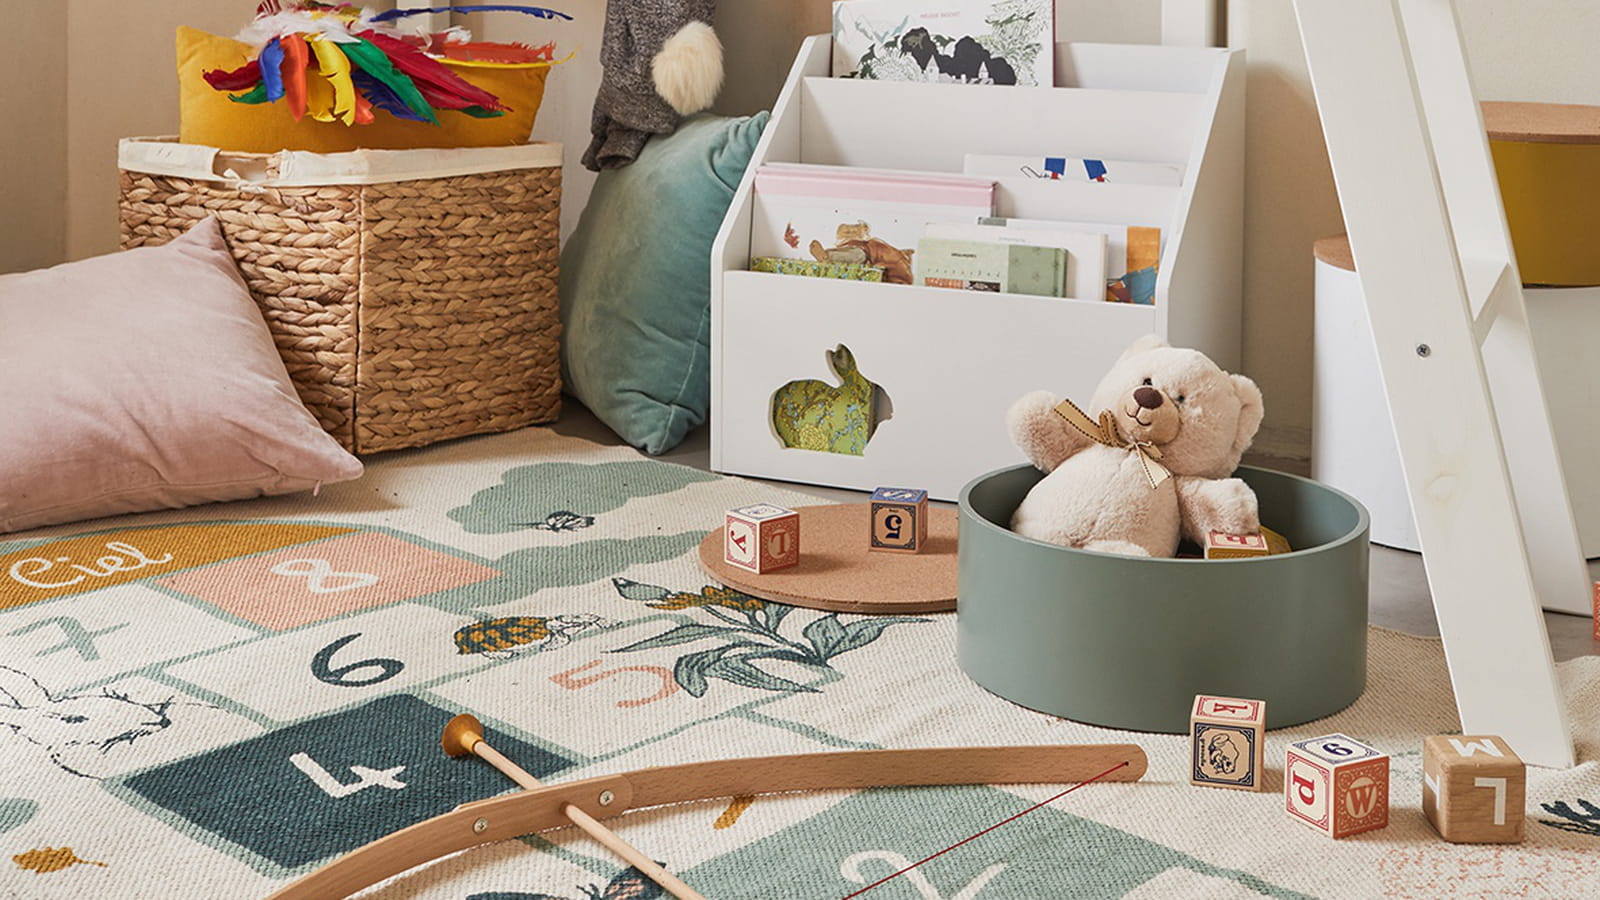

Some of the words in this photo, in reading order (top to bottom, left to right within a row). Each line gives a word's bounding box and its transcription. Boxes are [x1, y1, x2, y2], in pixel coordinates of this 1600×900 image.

[885, 514, 902, 539] 5
[9, 541, 173, 589] Ciel
[271, 558, 378, 594] 8
[6, 616, 131, 662] 7
[310, 632, 406, 687] 6
[548, 659, 680, 708] 5
[1322, 743, 1353, 756] 6
[288, 752, 407, 799] 4
[1347, 783, 1378, 816] W
[1474, 777, 1507, 825] L
